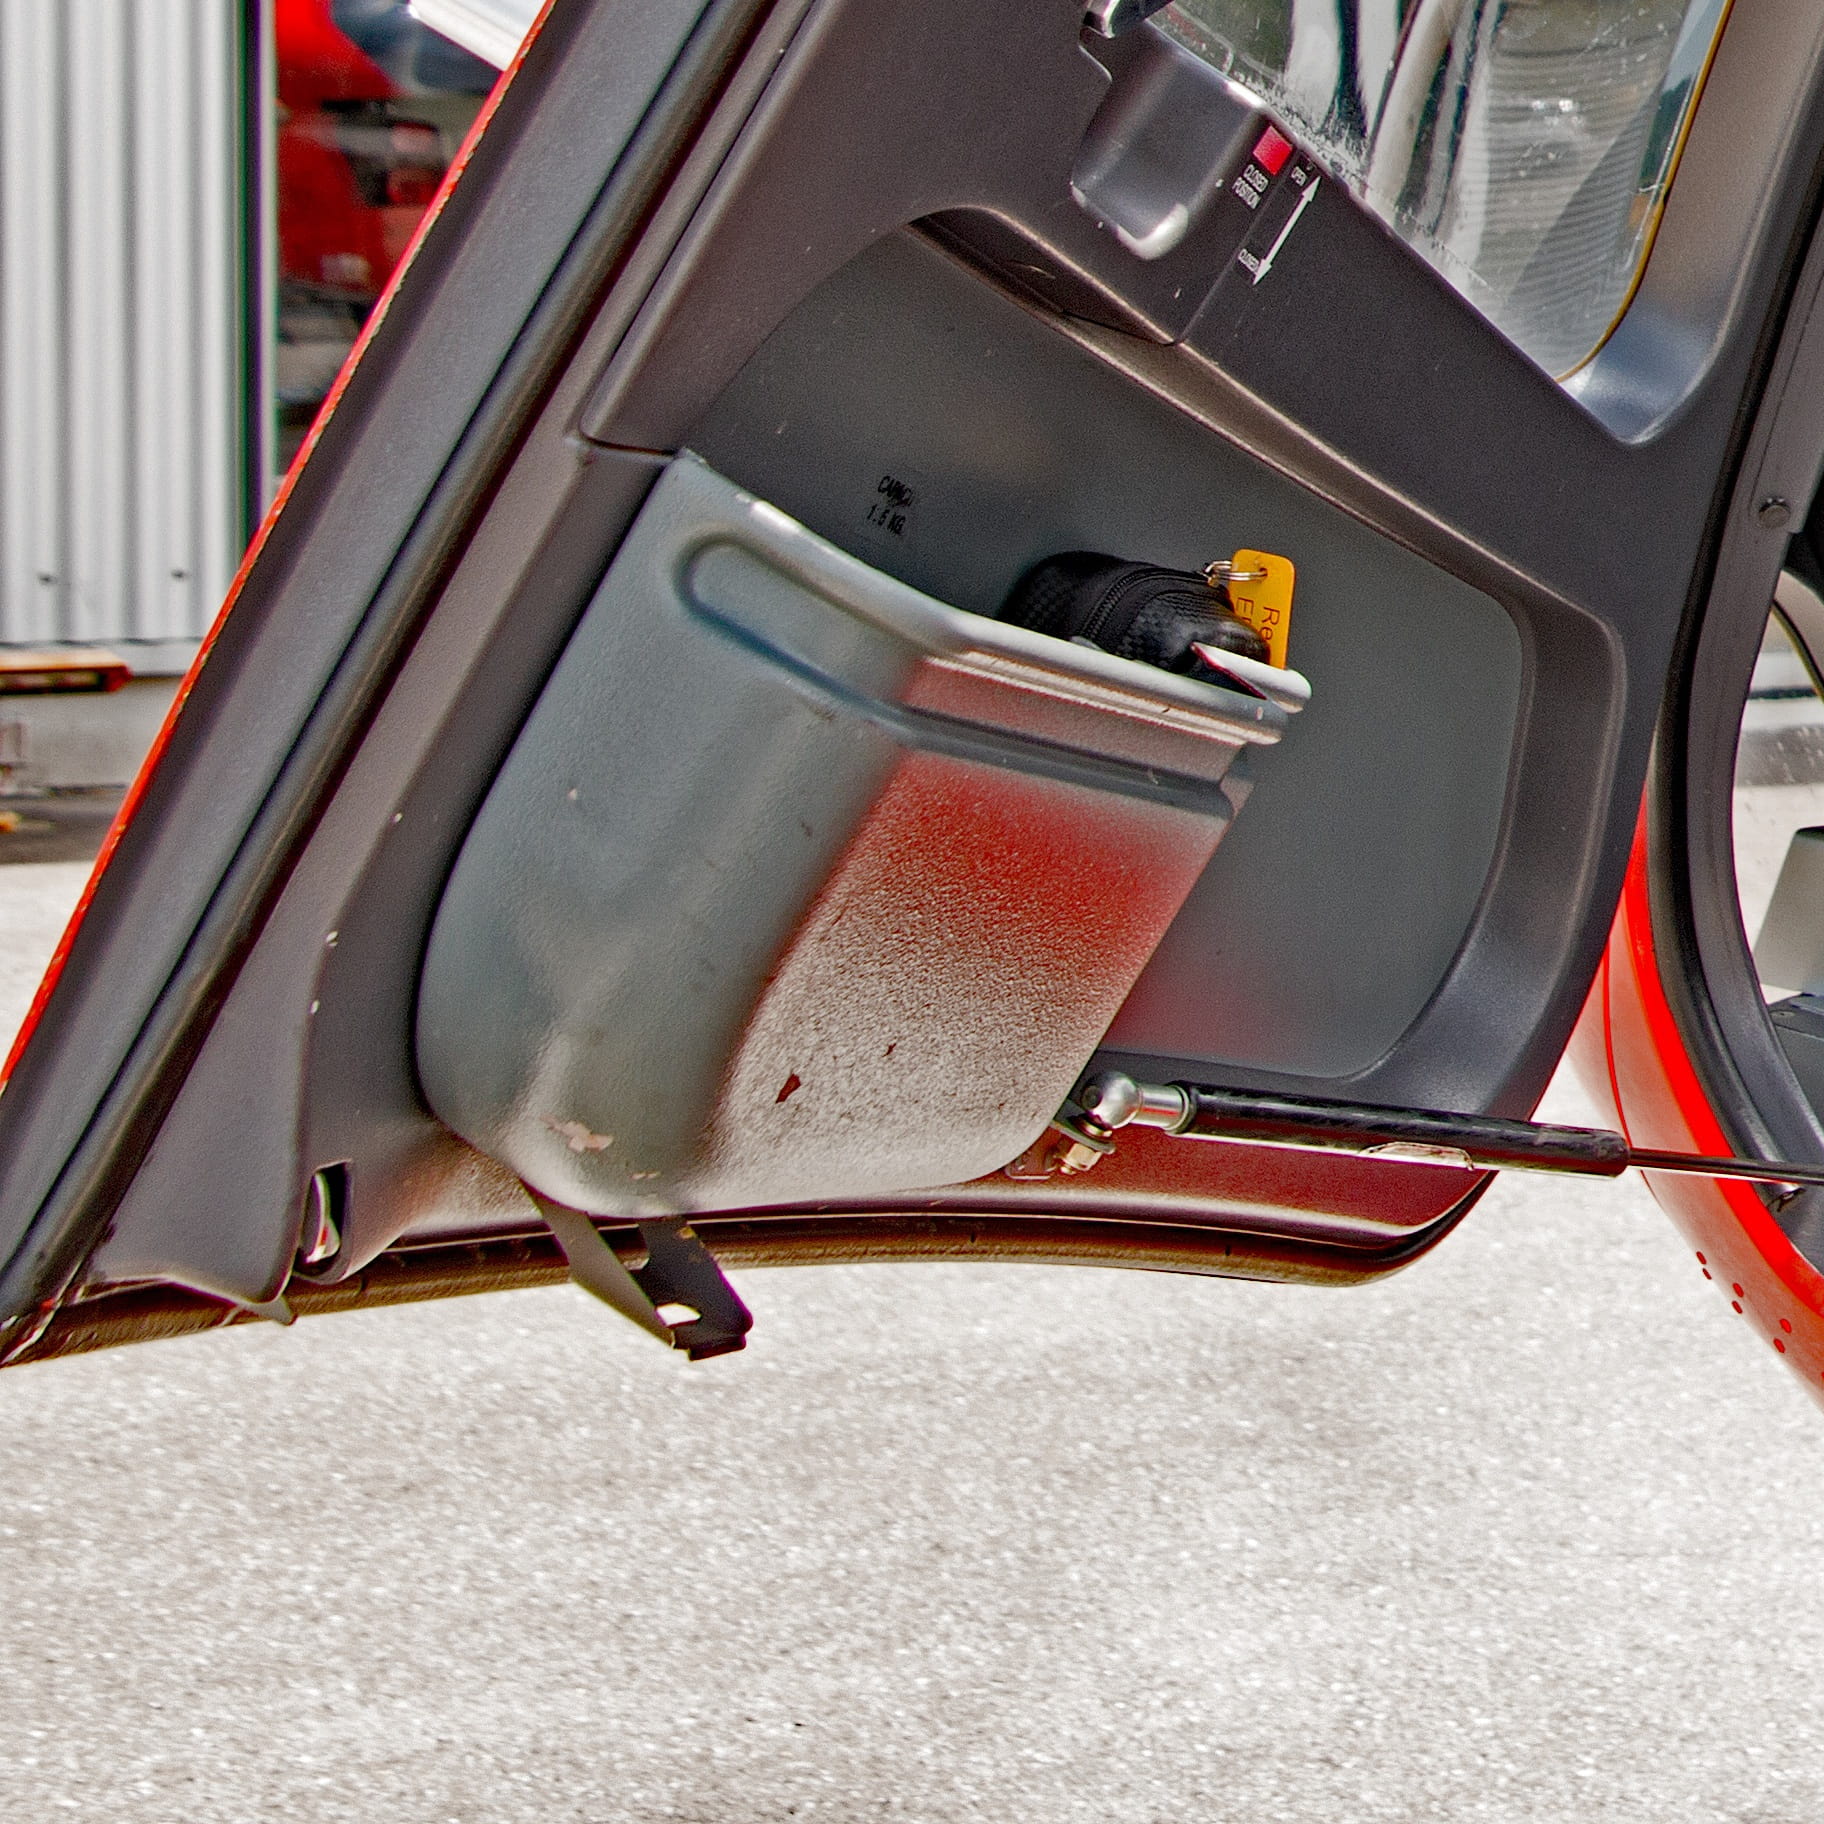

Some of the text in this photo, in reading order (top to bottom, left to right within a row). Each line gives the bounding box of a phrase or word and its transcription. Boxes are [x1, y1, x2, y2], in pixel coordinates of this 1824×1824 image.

[1243, 164, 1269, 193] CLOSED
[1291, 166, 1308, 187] OPEN
[1231, 176, 1261, 209] POSITION
